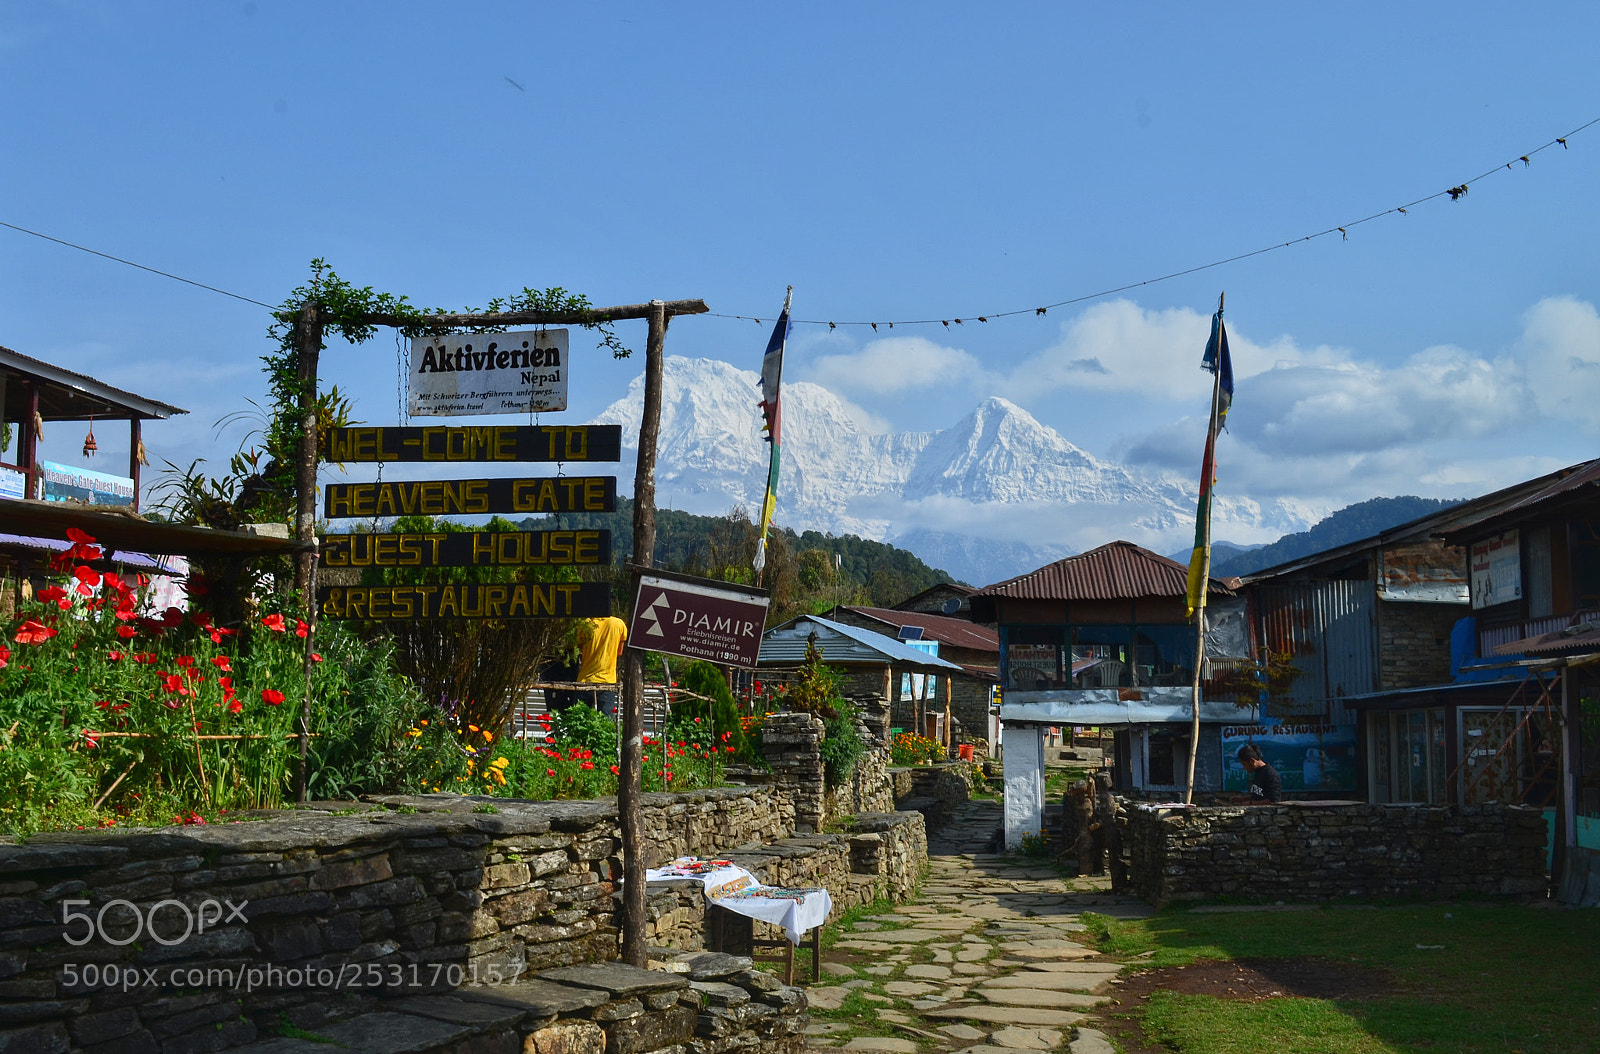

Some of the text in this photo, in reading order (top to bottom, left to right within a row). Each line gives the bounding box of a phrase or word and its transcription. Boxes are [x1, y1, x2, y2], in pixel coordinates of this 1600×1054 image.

[418, 341, 561, 373] Aktivferien
[521, 370, 560, 386] Nepal
[418, 393, 431, 401] Mit
[433, 392, 468, 400] Schweizer
[330, 426, 588, 461] WEL-COME TO
[46, 468, 134, 498] Heaven's Gate Guest House
[329, 478, 605, 516] HEAVENS GATE
[325, 531, 599, 566] GUEST HOUSE
[673, 609, 755, 638] DIAMIR
[687, 628, 737, 643] Erlebnisreisen
[680, 635, 741, 651] www.diamir.de
[680, 644, 714, 657] Pothana
[740, 656, 752, 664] m)
[1223, 725, 1268, 739] GURUNG
